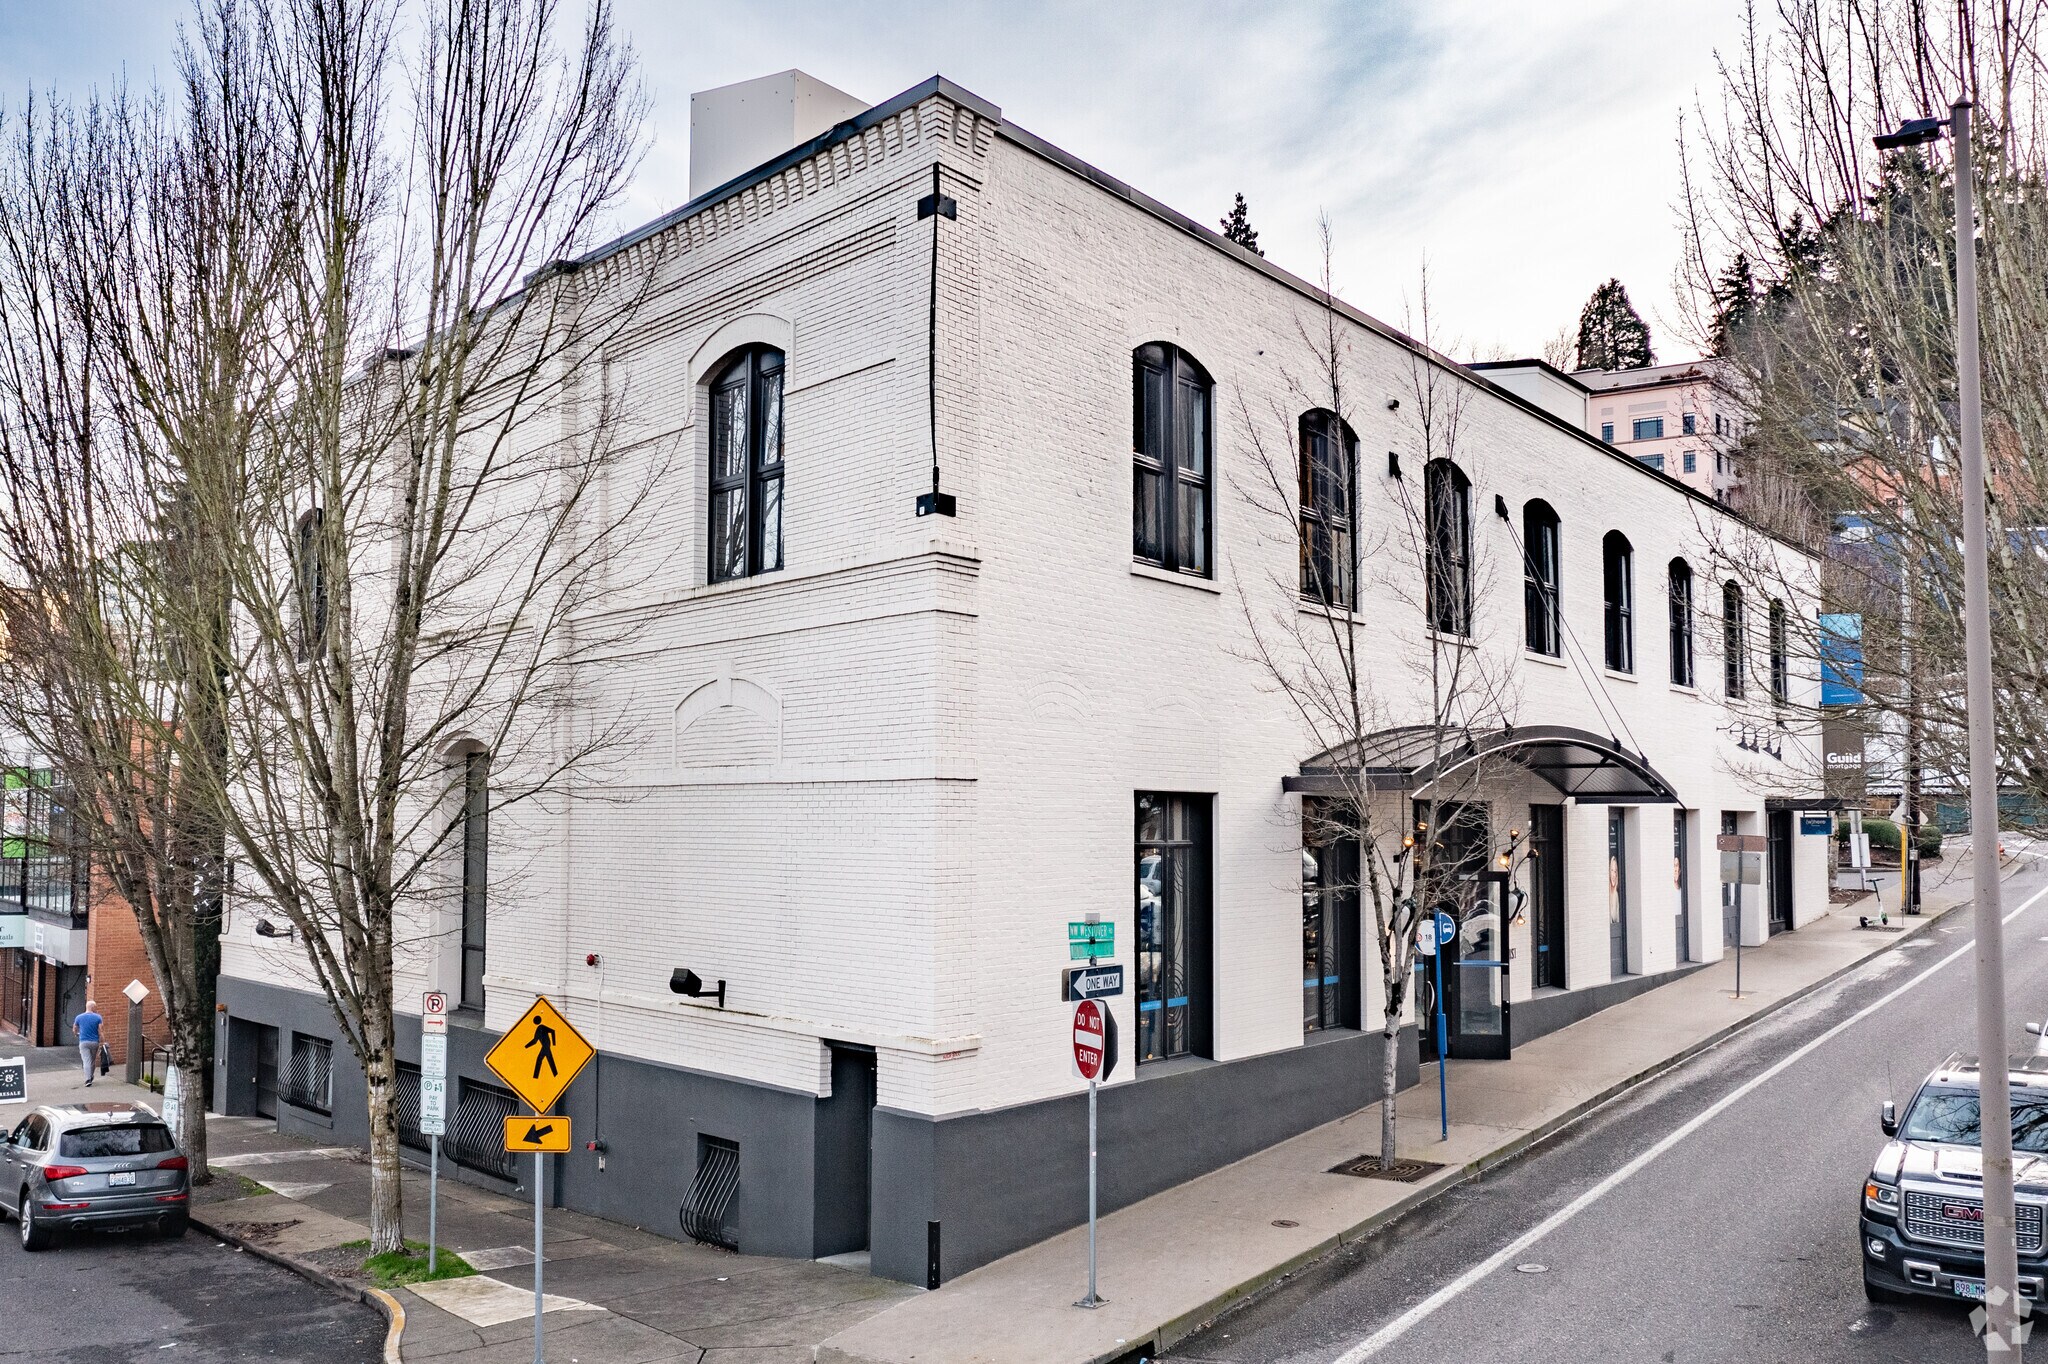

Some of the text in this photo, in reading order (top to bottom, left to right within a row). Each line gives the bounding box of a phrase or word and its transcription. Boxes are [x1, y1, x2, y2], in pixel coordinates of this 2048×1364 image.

[1827, 752, 1862, 763] Guild
[1080, 925, 1107, 937] WESTOVER
[1086, 975, 1118, 990] ONE WAY
[1077, 1012, 1100, 1030] DO NOT
[1079, 1049, 1098, 1066] ENTER
[1945, 1205, 1984, 1220] GM
[1956, 1282, 1970, 1293] 898
